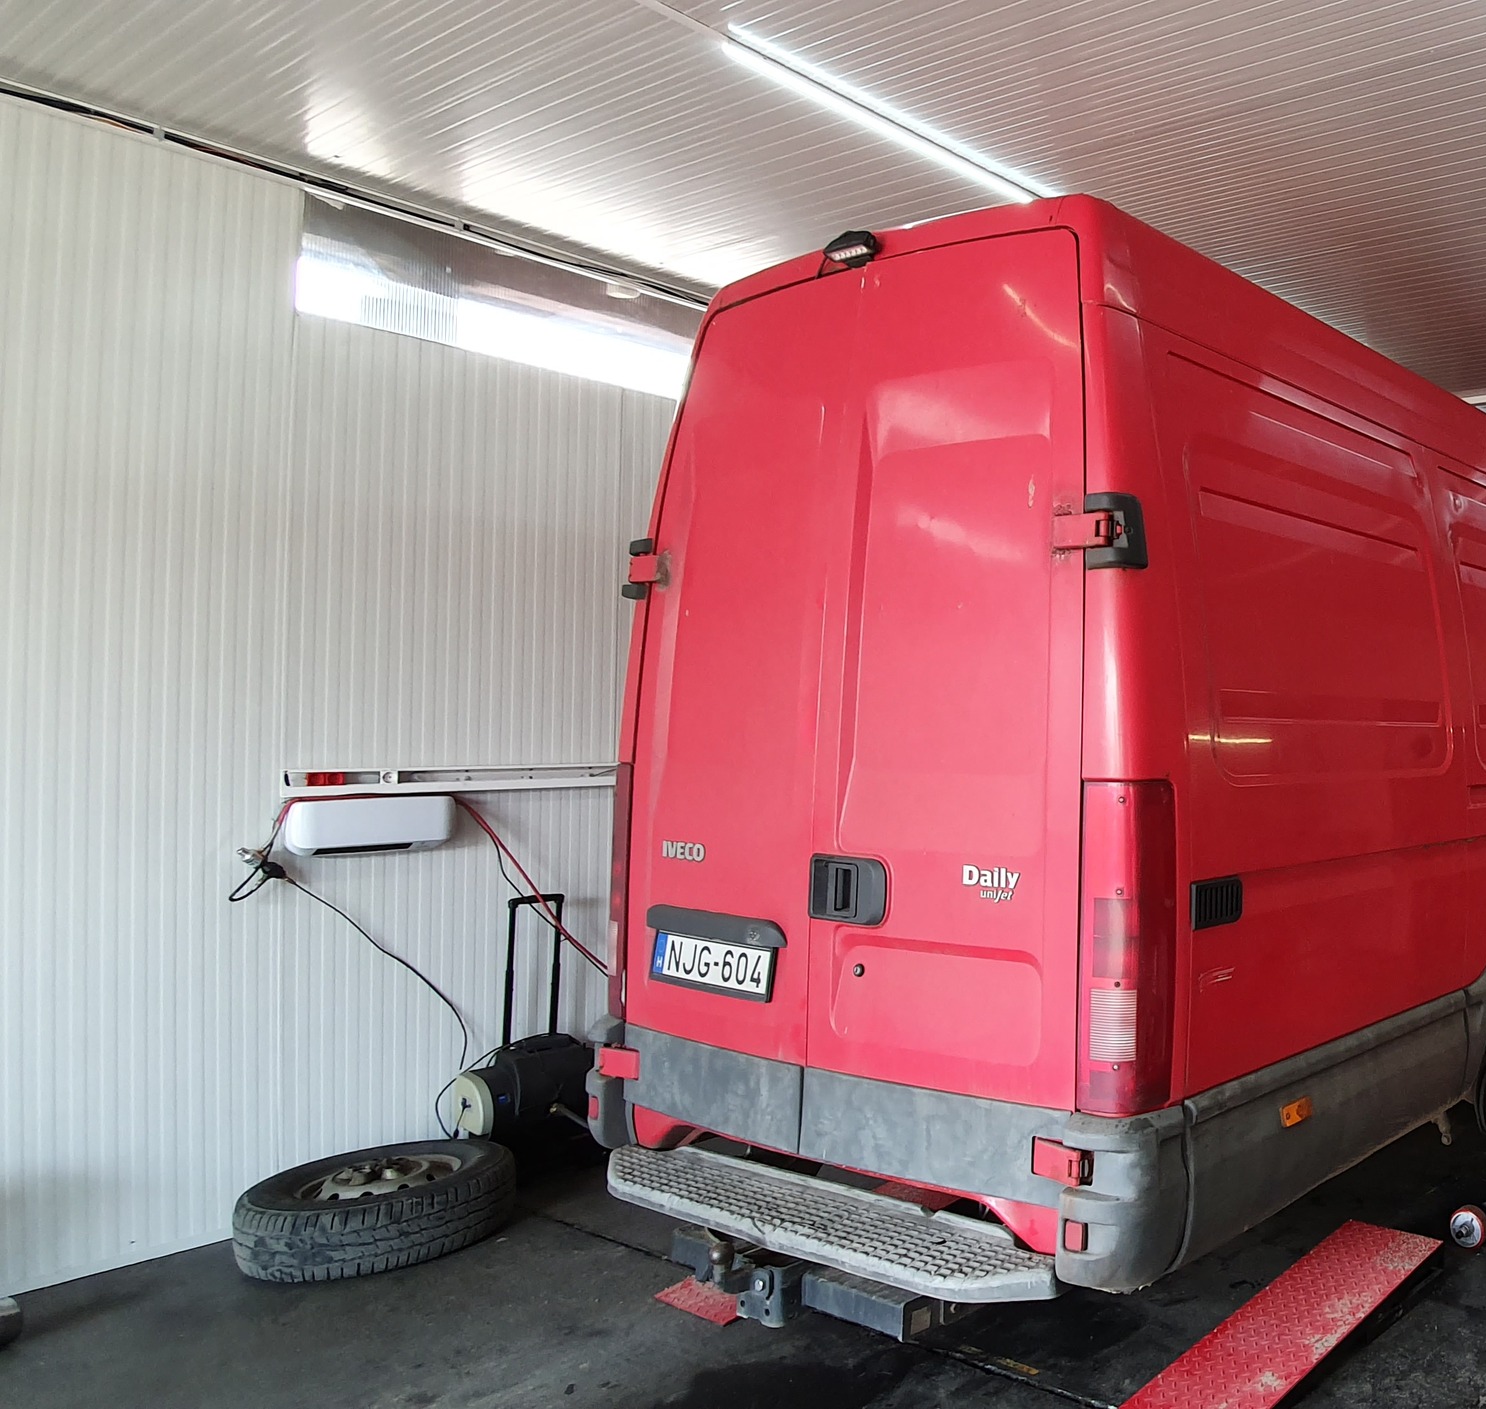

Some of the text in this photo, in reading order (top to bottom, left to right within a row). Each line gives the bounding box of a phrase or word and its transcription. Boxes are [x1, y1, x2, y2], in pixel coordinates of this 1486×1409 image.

[661, 840, 706, 863] IVECO
[962, 864, 1021, 889] Daily
[656, 956, 663, 968] H
[667, 940, 762, 989] NJG-604
